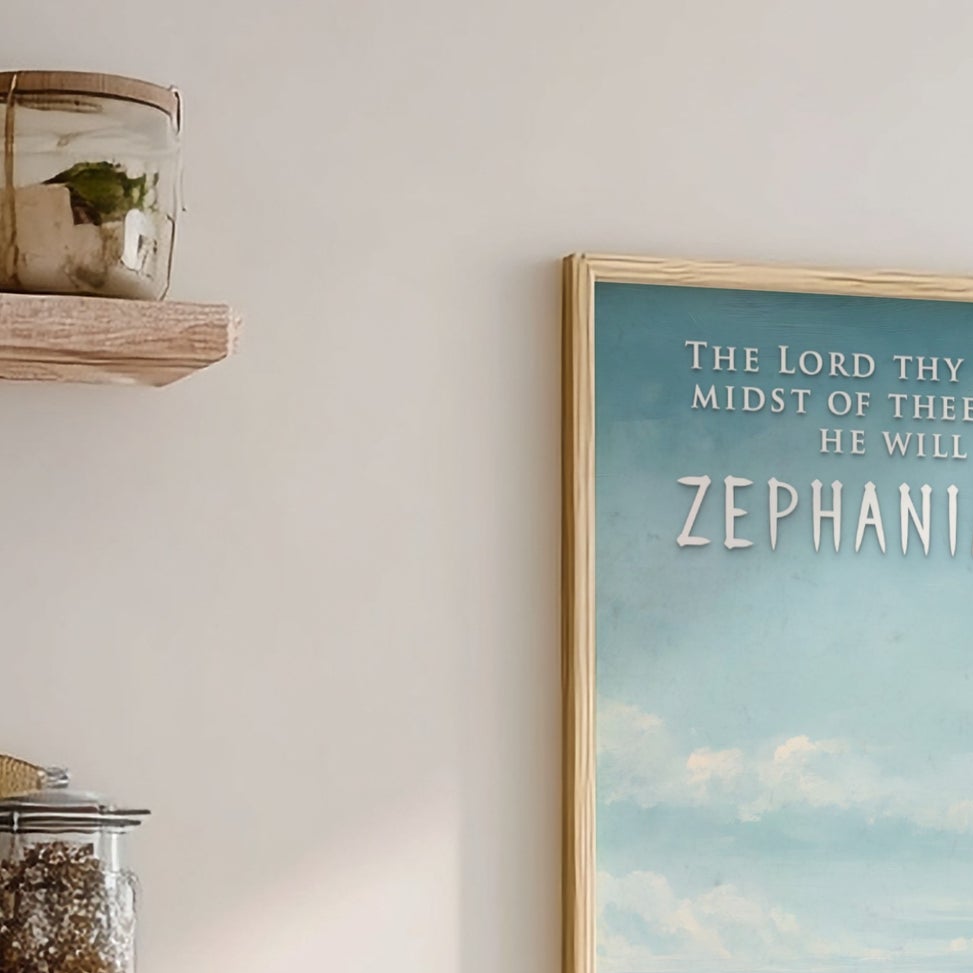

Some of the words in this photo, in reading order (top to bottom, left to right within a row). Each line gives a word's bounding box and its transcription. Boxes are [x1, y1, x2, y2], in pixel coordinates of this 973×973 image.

[685, 341, 760, 372] THE
[779, 346, 875, 378] LORD
[893, 355, 964, 382] THY
[691, 384, 811, 413] MIDST
[828, 391, 870, 415] OF
[820, 429, 865, 454] HE
[883, 432, 967, 459] WILL
